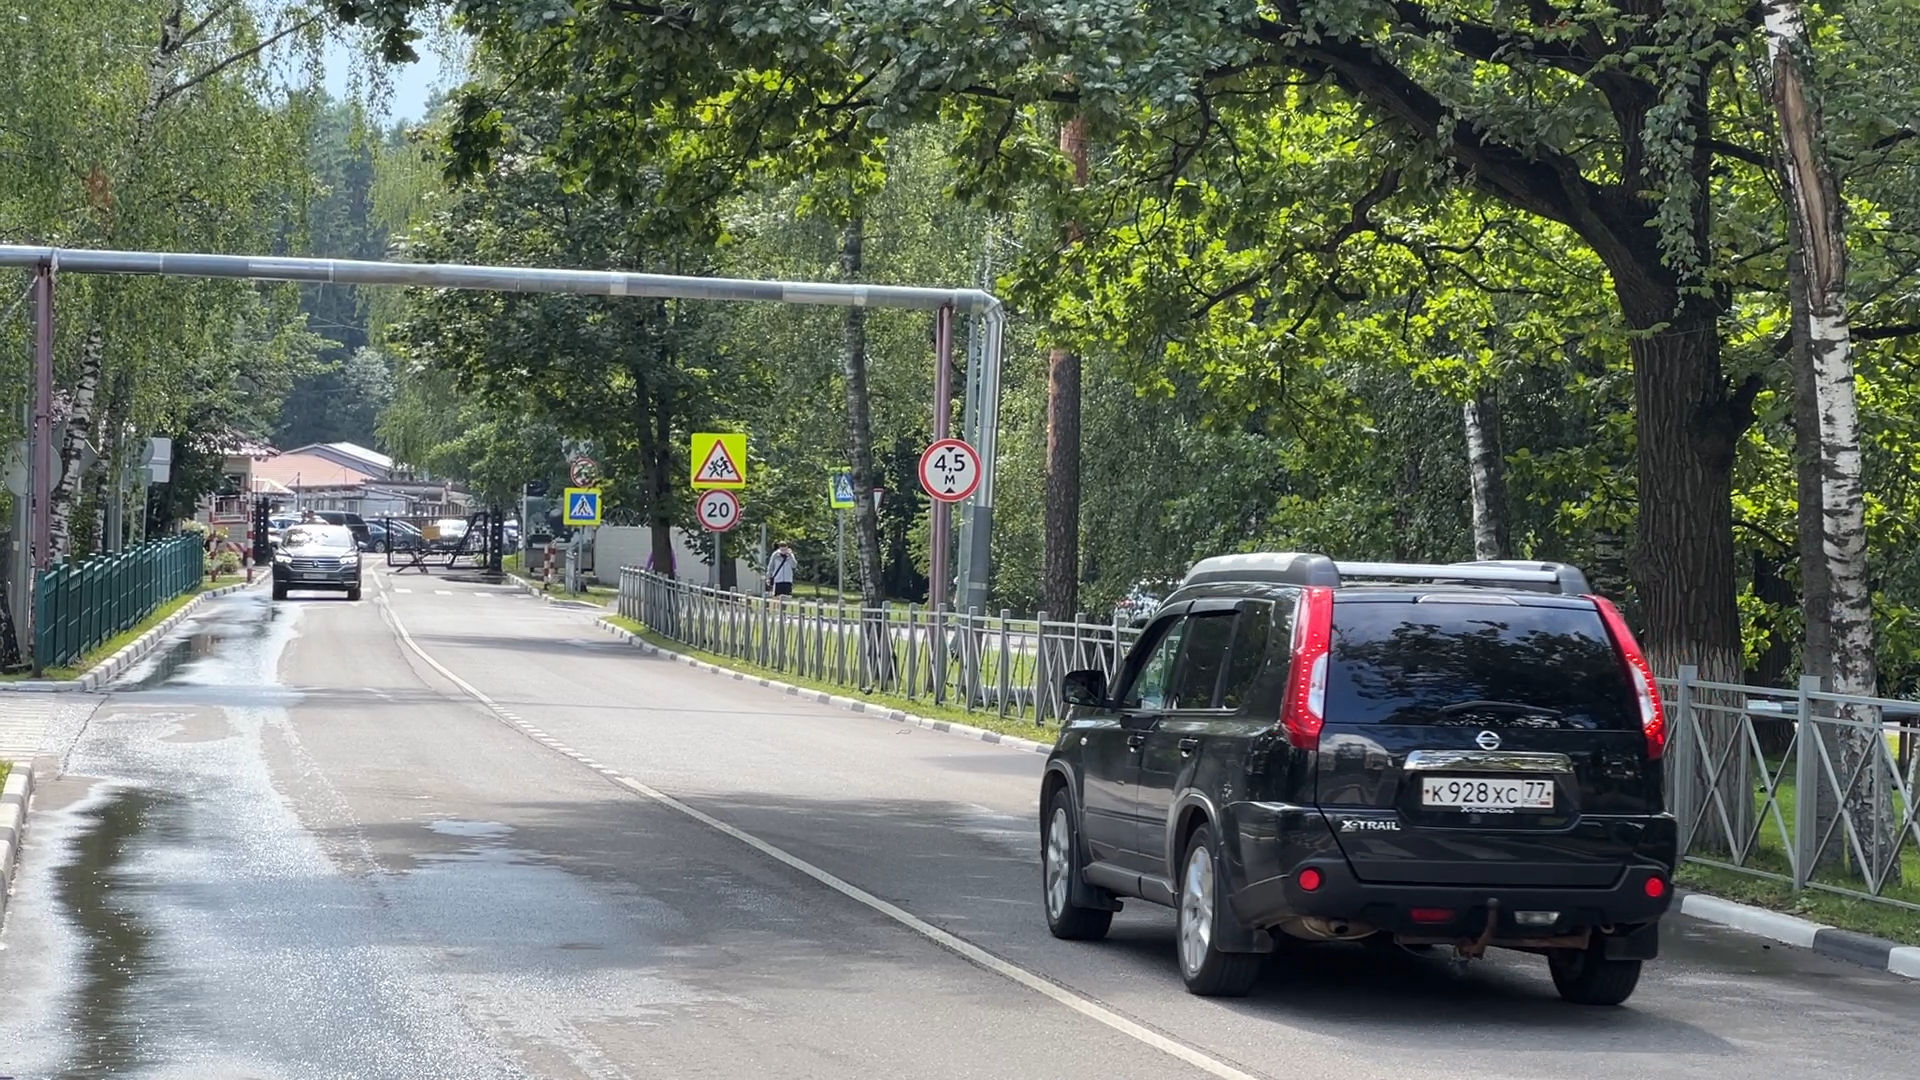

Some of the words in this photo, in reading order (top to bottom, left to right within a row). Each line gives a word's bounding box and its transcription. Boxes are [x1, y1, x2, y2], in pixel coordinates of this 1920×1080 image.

[934, 454, 966, 474] 4,5
[707, 502, 730, 518] 20
[1341, 820, 1401, 831] X-TRAIL
